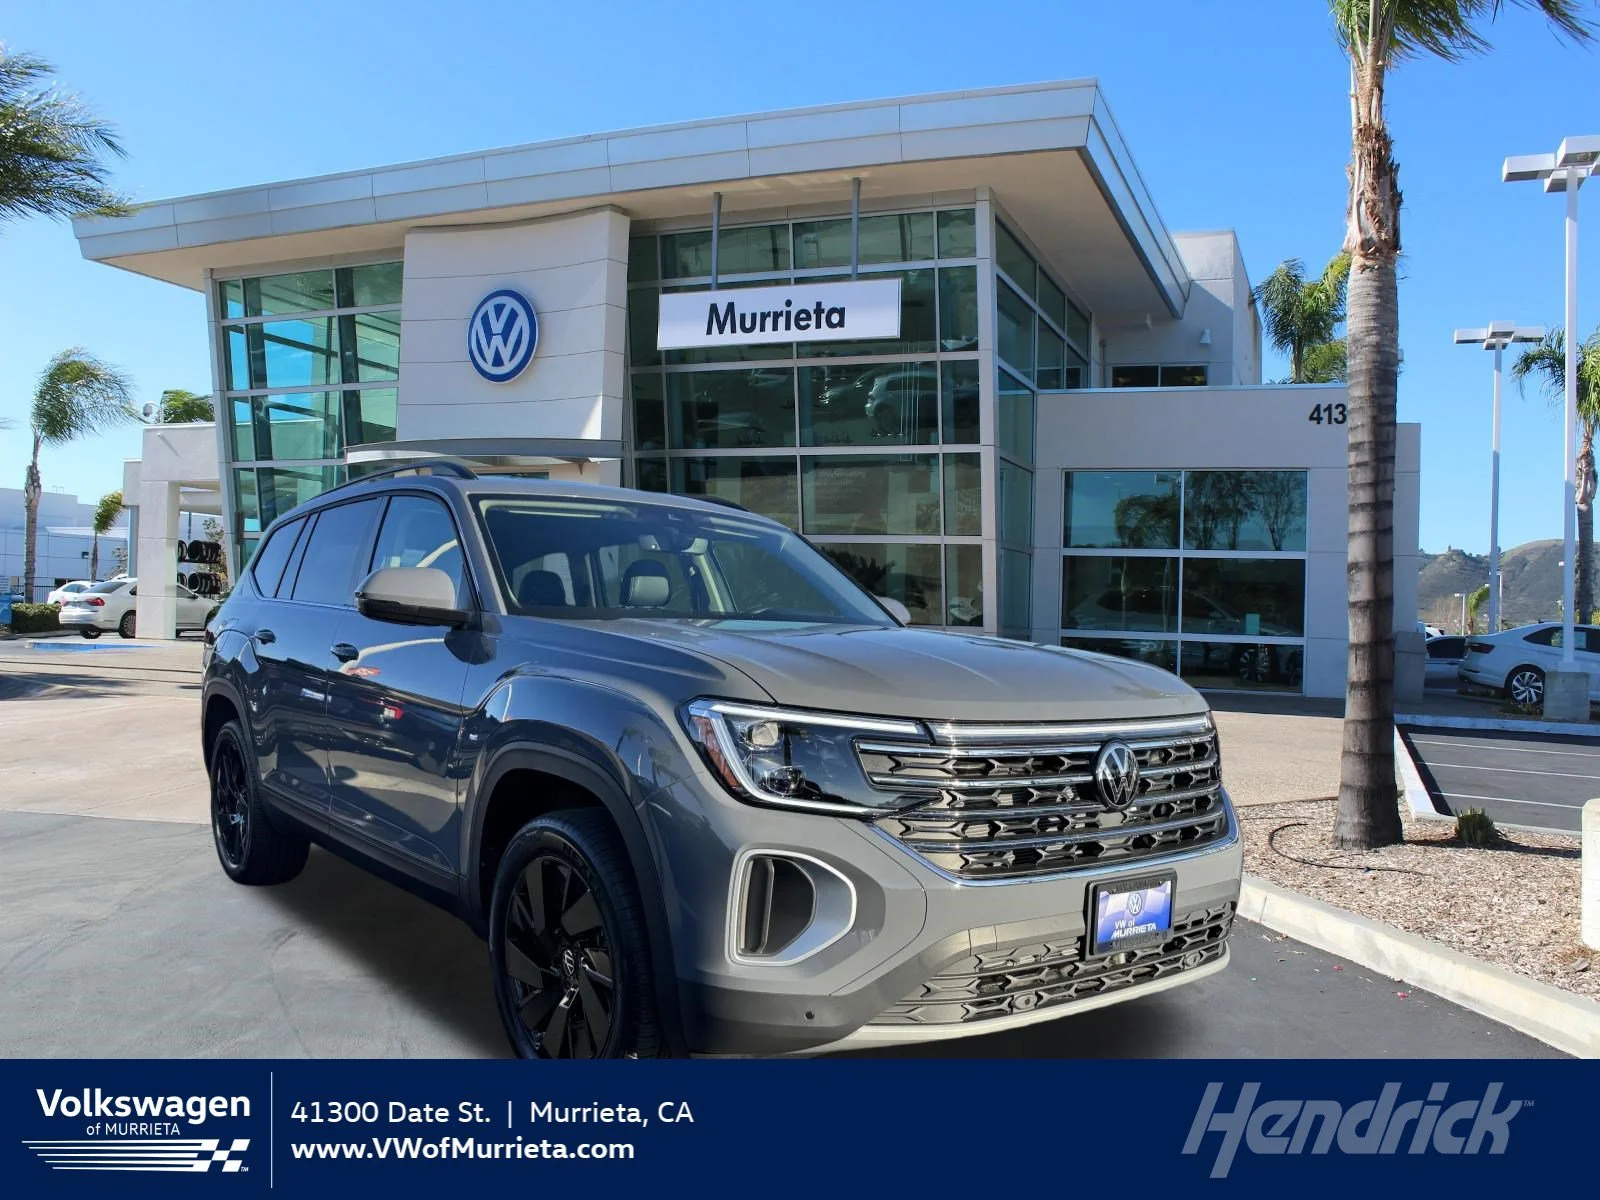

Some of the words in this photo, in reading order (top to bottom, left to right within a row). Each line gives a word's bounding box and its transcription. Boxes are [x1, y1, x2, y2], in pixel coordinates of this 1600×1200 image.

[705, 299, 847, 336] Murrieta
[1111, 922, 1157, 940] MURRIETA
[1115, 919, 1127, 929] VW
